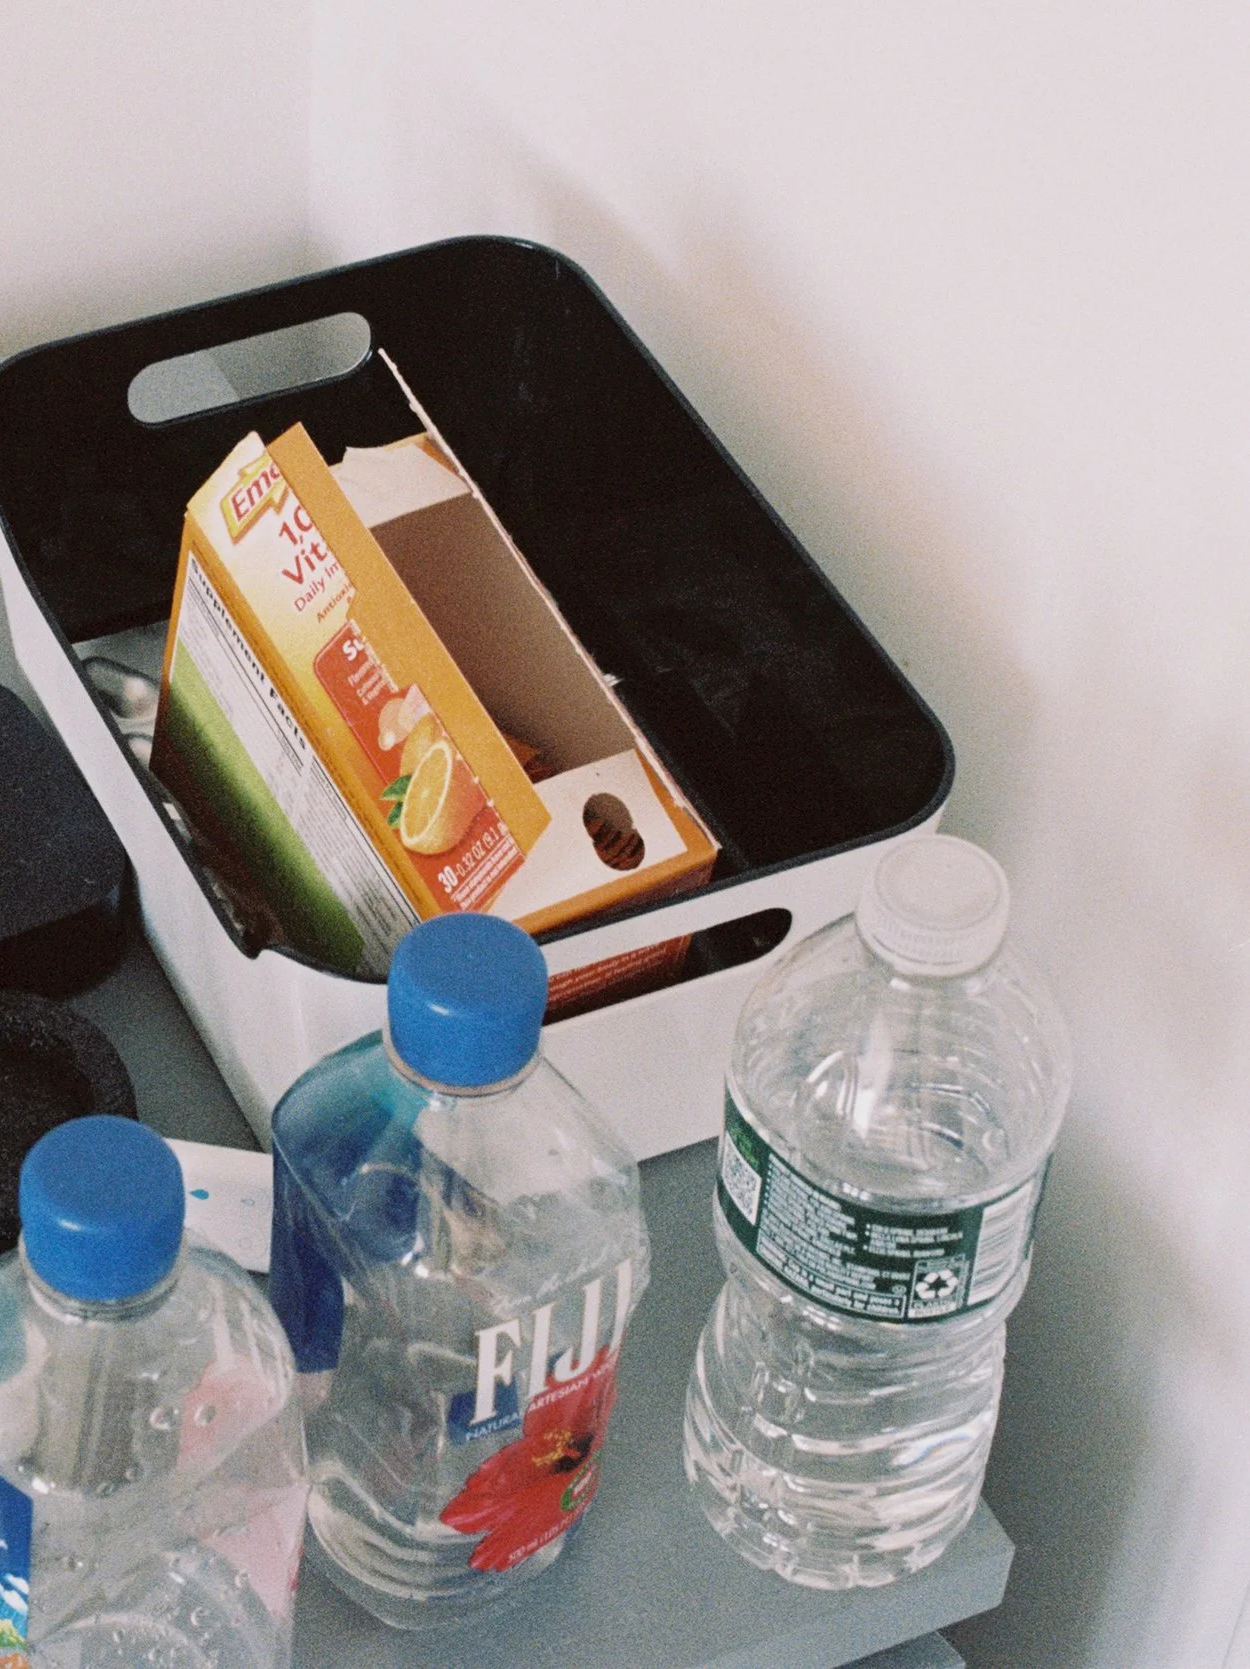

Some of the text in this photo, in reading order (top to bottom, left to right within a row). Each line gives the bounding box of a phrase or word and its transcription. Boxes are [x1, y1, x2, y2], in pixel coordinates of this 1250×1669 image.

[281, 541, 330, 584] Vit
[294, 577, 326, 612] Daily
[190, 557, 265, 683] Supplement
[269, 686, 306, 751] Facts
[471, 1258, 632, 1425] FIJI
[527, 1376, 590, 1413] ARTESIAN
